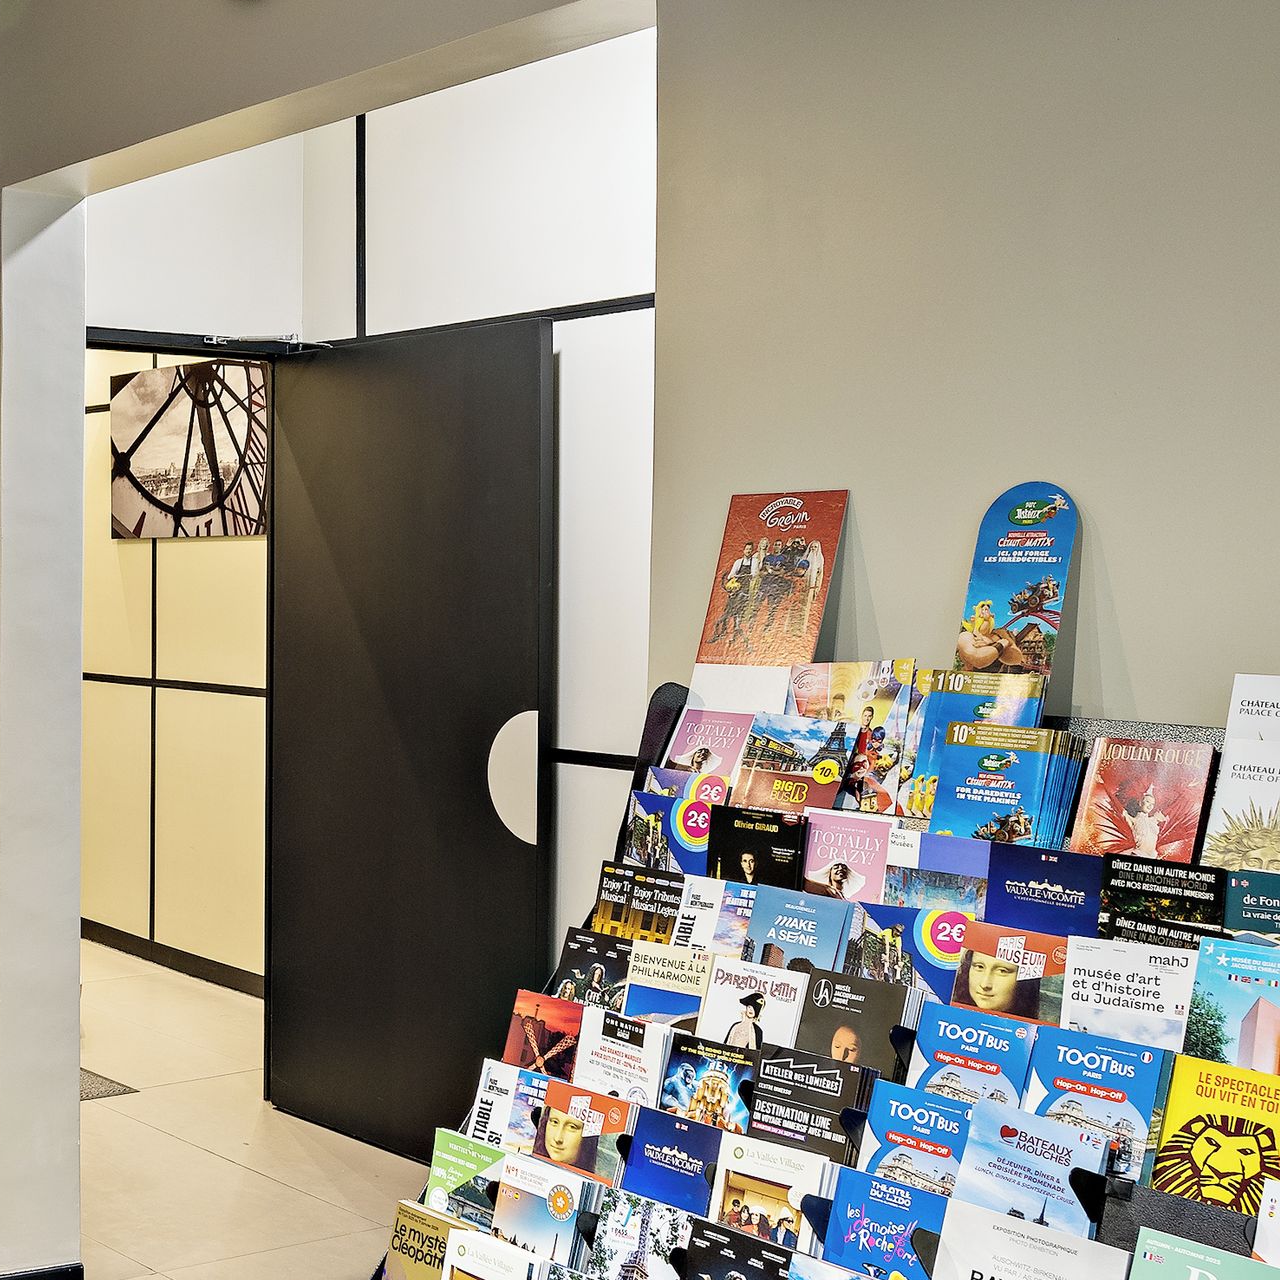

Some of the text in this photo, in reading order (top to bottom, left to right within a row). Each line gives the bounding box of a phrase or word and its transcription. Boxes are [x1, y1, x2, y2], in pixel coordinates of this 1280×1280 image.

[760, 498, 803, 520] INCROYABLE
[766, 510, 811, 532] Grévin
[1239, 707, 1272, 717] PALACE
[685, 722, 745, 741] TOTALLY
[686, 733, 736, 749] CRAZY!
[952, 724, 976, 744] 10%
[1101, 743, 1203, 767] MOULIN ROUGE
[1232, 764, 1276, 775] CHÂTEAU
[772, 779, 794, 792] BIG
[955, 786, 1021, 799] FOR DAREDEVILS
[686, 810, 710, 828] 2€
[733, 819, 779, 834] Olivier GIRAUD
[810, 830, 884, 852] TOTALLY
[890, 832, 906, 841] Paris
[890, 838, 914, 849] Musées
[816, 845, 877, 865] CRAZY!
[1111, 859, 1216, 883] DÎNEZ DANS UN AUTRE MONDE
[1118, 871, 1208, 891] DINE IN ANOTHER WORLD
[633, 885, 653, 900] Enjoy
[653, 889, 681, 905] Tributes
[1110, 878, 1215, 901] AVEC NOS RESTAURANTS IMMERSIFS
[774, 914, 818, 932] MAKE
[1242, 910, 1272, 920] La vraie
[936, 922, 966, 943] 2€
[999, 937, 1026, 950] PARIS
[633, 952, 707, 974] BIENVENUE À LA
[996, 947, 1046, 967] MUSEUM
[1148, 954, 1190, 969] mahJ
[631, 966, 702, 986] PHILHARMONIE
[1018, 966, 1044, 978] PASS
[1073, 965, 1161, 987] musée d'art
[714, 967, 799, 1003] PARADIS LATIN
[834, 982, 852, 993] MUSÉE
[1072, 978, 1162, 1000] et d'histoire
[832, 996, 850, 1007] ANDRÉ
[834, 990, 866, 1003] JACQUEMART
[1071, 989, 1165, 1014] du Judaïsme
[937, 1020, 1010, 1053] TOOTBUS
[960, 1044, 980, 1054] PARIS
[936, 1051, 998, 1074] Hop-On Hop-Off
[1056, 1044, 1136, 1078] TOOTBUS
[764, 1067, 840, 1093] ATELIER DES LUMIÈRES
[1082, 1069, 1103, 1081] PARIS
[1056, 1077, 1123, 1101] Hop-On Hop-Off
[1198, 1071, 1280, 1101] LE SPECTACLE
[1195, 1084, 1280, 1114] QUI VIT EN TOI
[754, 1098, 832, 1130] DESTINATION LUNE
[888, 1098, 961, 1135] TOOTBUS
[912, 1124, 931, 1136] PARIS
[888, 1132, 949, 1156] Hop-On Hop-Off
[1014, 1140, 1072, 1168] MOUCHES
[1018, 1130, 1074, 1160] BATEAUX
[988, 1161, 1066, 1195] CROISIÈRE PROMENADE
